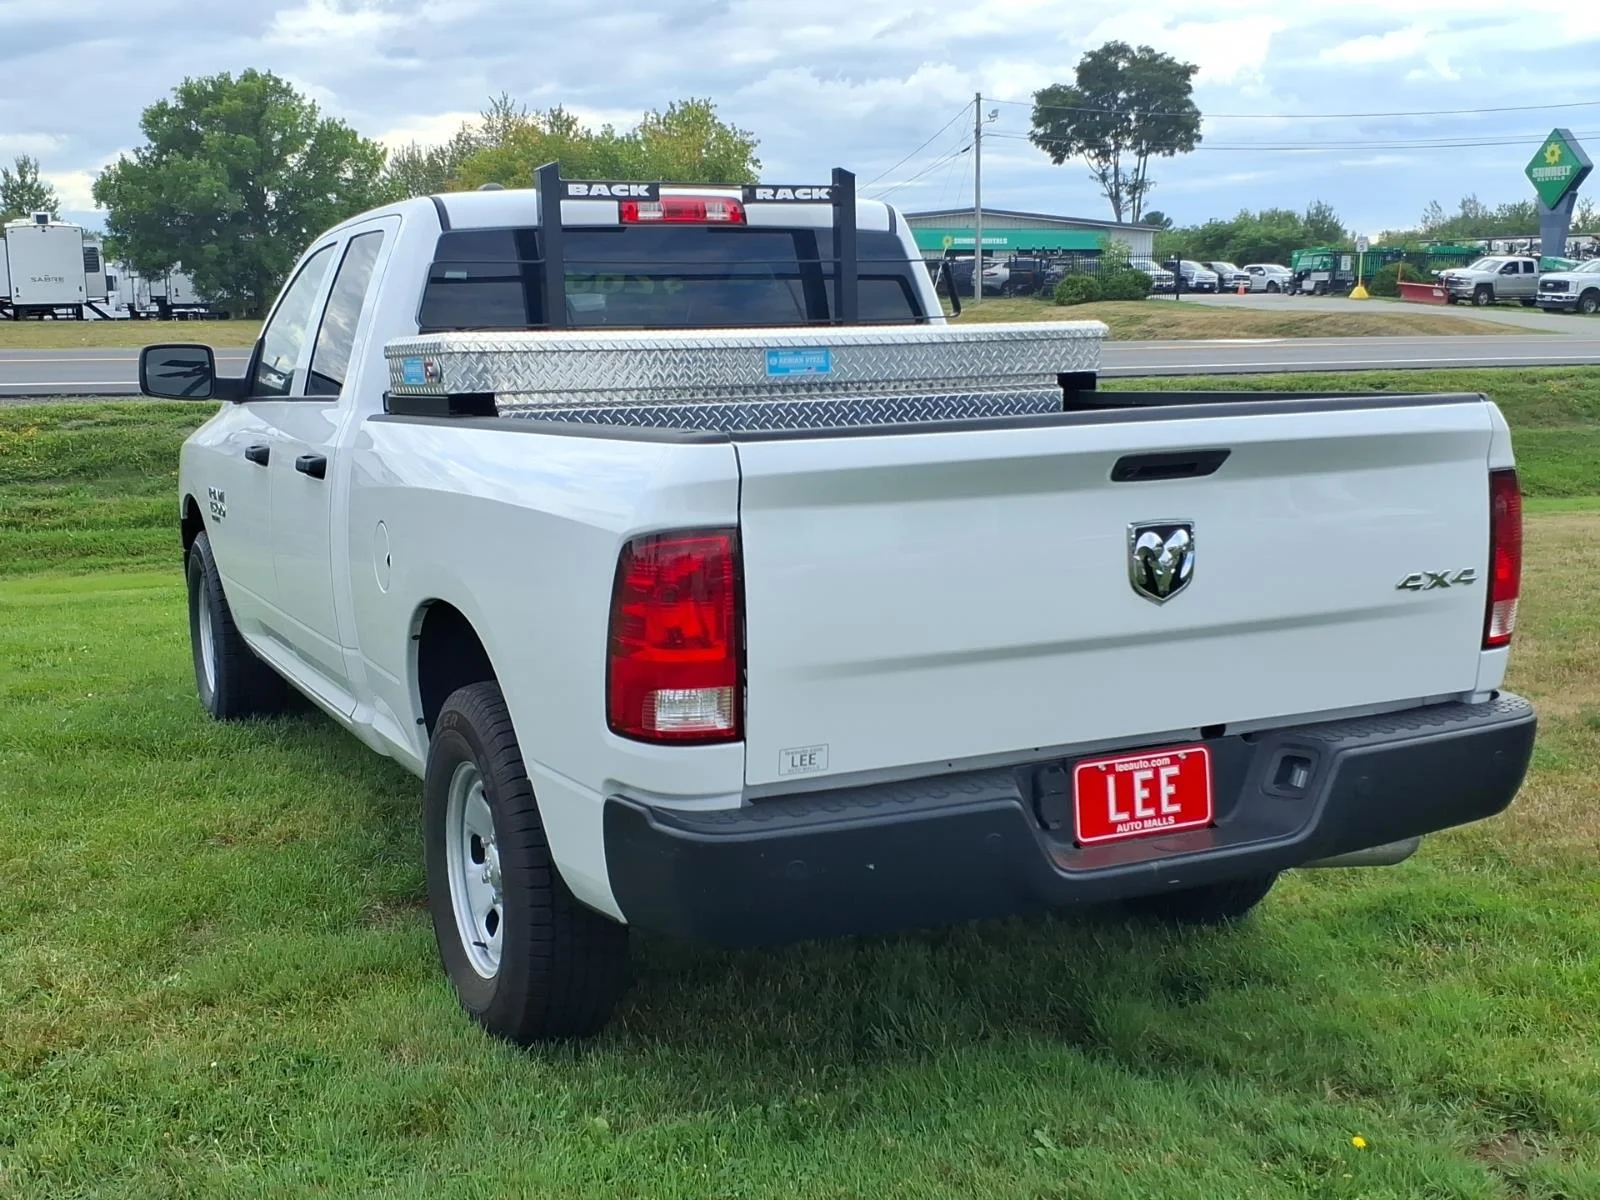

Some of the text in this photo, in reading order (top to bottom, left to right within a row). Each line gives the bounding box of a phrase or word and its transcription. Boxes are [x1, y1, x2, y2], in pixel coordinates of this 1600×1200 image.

[567, 183, 831, 200] BACK RACK
[791, 752, 817, 768] LEE
[1115, 757, 1171, 772] leeauto.com
[1106, 765, 1182, 823] LEE
[1116, 816, 1175, 833] AUTO MALLS
